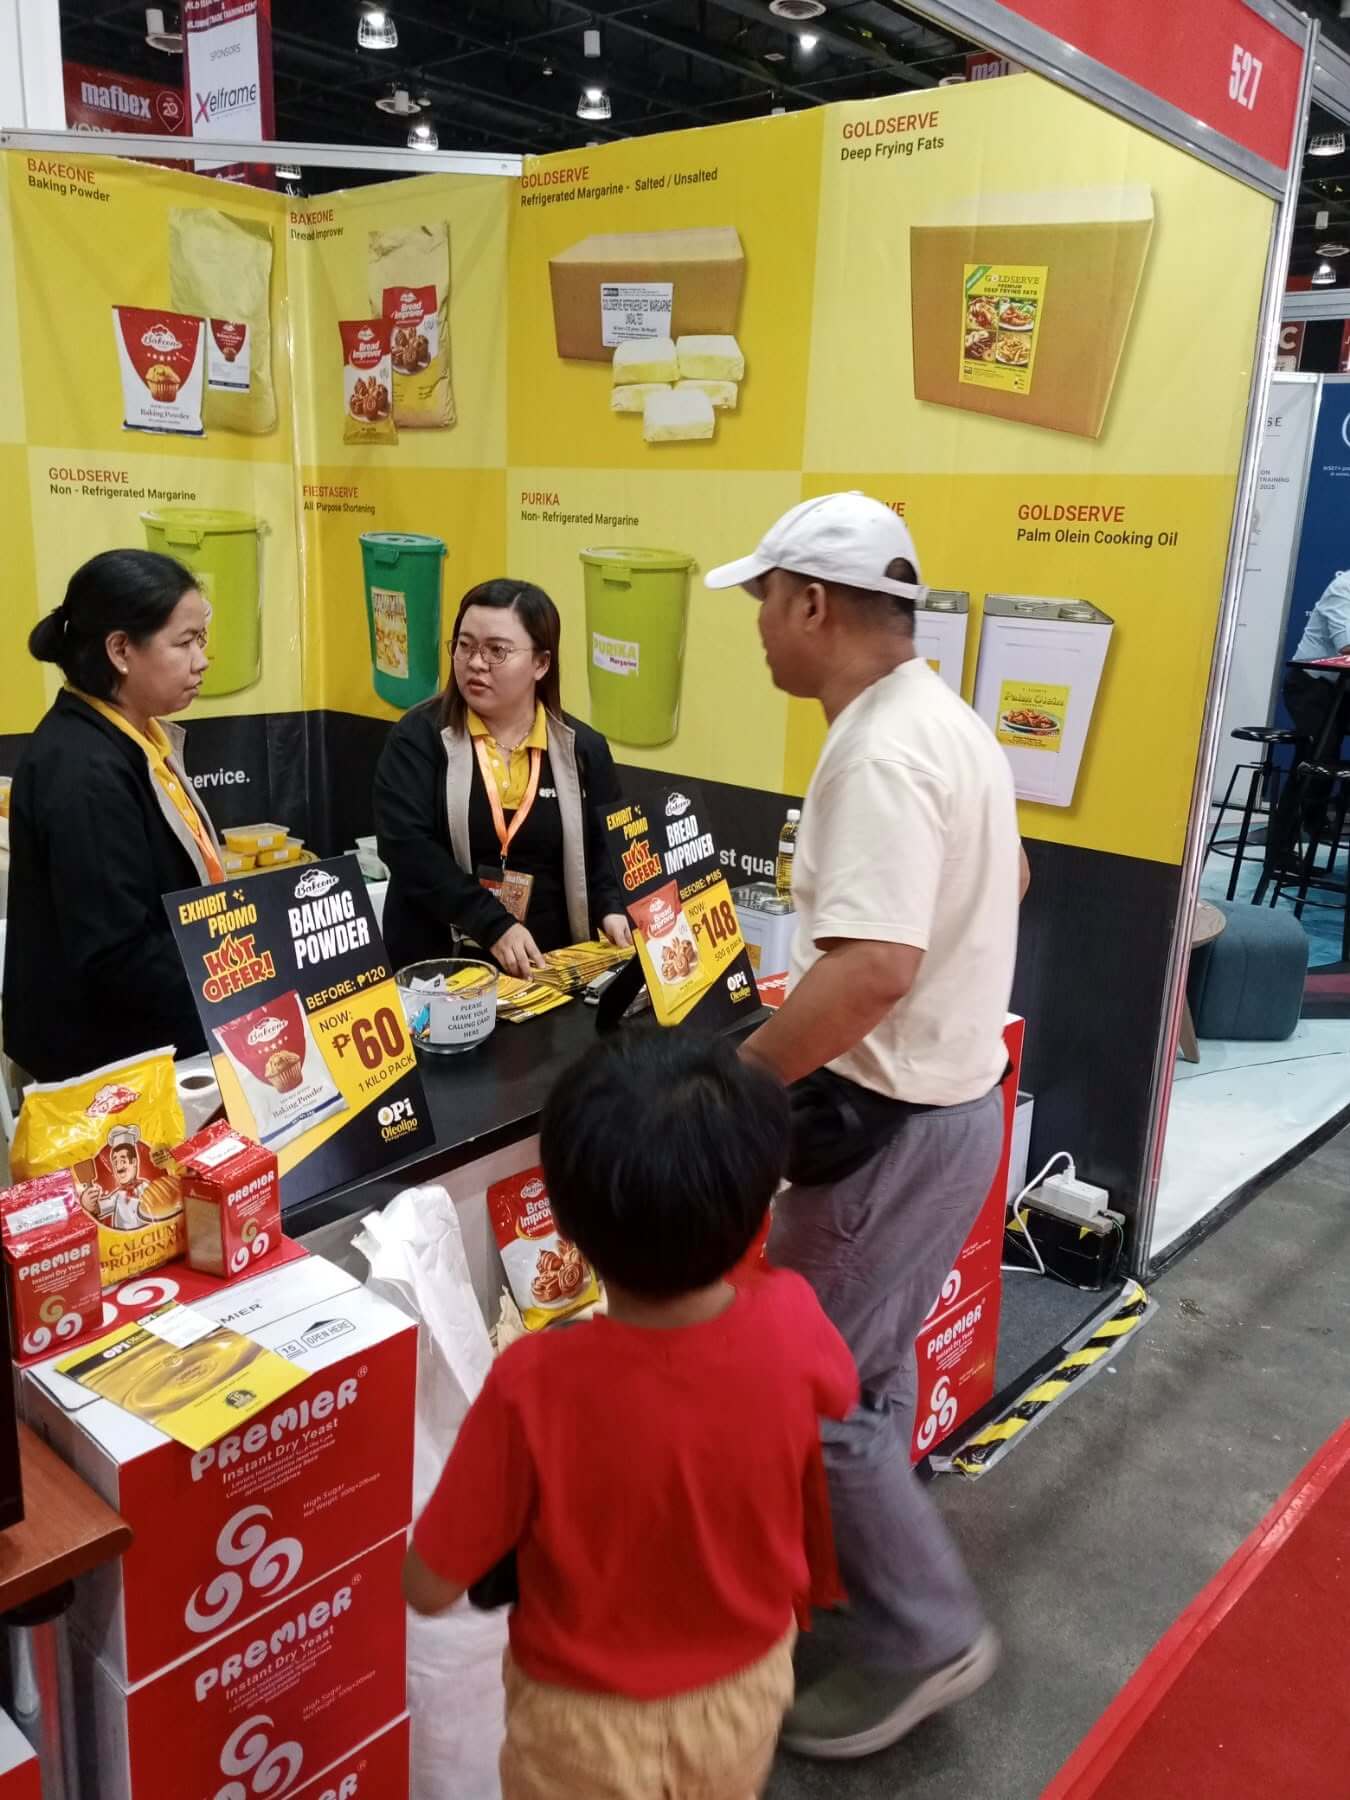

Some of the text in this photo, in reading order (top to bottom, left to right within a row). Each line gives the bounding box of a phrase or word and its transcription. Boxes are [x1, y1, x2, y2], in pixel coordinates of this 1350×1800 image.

[1229, 44, 1263, 110] 527
[81, 80, 151, 119] mafbex
[842, 111, 940, 140] GOLDSERVE
[841, 136, 945, 162] Deep Frying Fats
[27, 158, 97, 185] BAKEONE
[521, 166, 590, 189] GOLDSERVE
[28, 175, 111, 203] Baking Powder
[521, 188, 576, 208] Refrigerated
[577, 184, 624, 200] Margarine
[635, 175, 665, 192] Salted
[673, 168, 719, 187] Unsalted
[290, 208, 335, 226] BAKEONE
[49, 467, 129, 484] GOLDSERVE
[50, 484, 71, 495] Non
[82, 485, 145, 500] Refrigerated
[148, 487, 197, 502] Margarine
[521, 491, 561, 506] PURIKA
[342, 503, 375, 515] Shortening
[542, 511, 594, 526] Refrigerated
[595, 513, 639, 528] Margarine
[1018, 504, 1126, 523] GOLDSERVE
[1016, 528, 1178, 549] Palm Olein Cooking Oil
[606, 805, 633, 831] EXHIBIT
[623, 817, 649, 840] PROMO
[665, 814, 699, 848] BREAD
[621, 838, 651, 871] HOT
[664, 832, 715, 876] IMPROVER
[623, 853, 663, 891] OFFER!
[179, 891, 228, 926] EXHIBIT
[208, 904, 258, 938] PROMO
[288, 890, 355, 938] BAKING
[203, 934, 256, 977] HOT
[294, 916, 370, 970] POWDER
[203, 951, 276, 1003] OFFER!
[305, 980, 357, 1010] BEFORE:
[319, 1009, 353, 1032] NOW:
[364, 1070, 388, 1089] KILO
[389, 1053, 415, 1076] PACK
[271, 1100, 300, 1119] Baking
[297, 1084, 324, 1106] Powder
[520, 1208, 552, 1229] Improv
[526, 1197, 550, 1216] Brea
[108, 1222, 177, 1257] CALCIUM
[99, 1237, 177, 1272] PROPIONA
[220, 1302, 263, 1324] MIER
[306, 1320, 351, 1346] OPEN HERE
[223, 1418, 338, 1484] Instant Dry Yeast
[226, 1624, 334, 1700] Instant Dry Yeast
